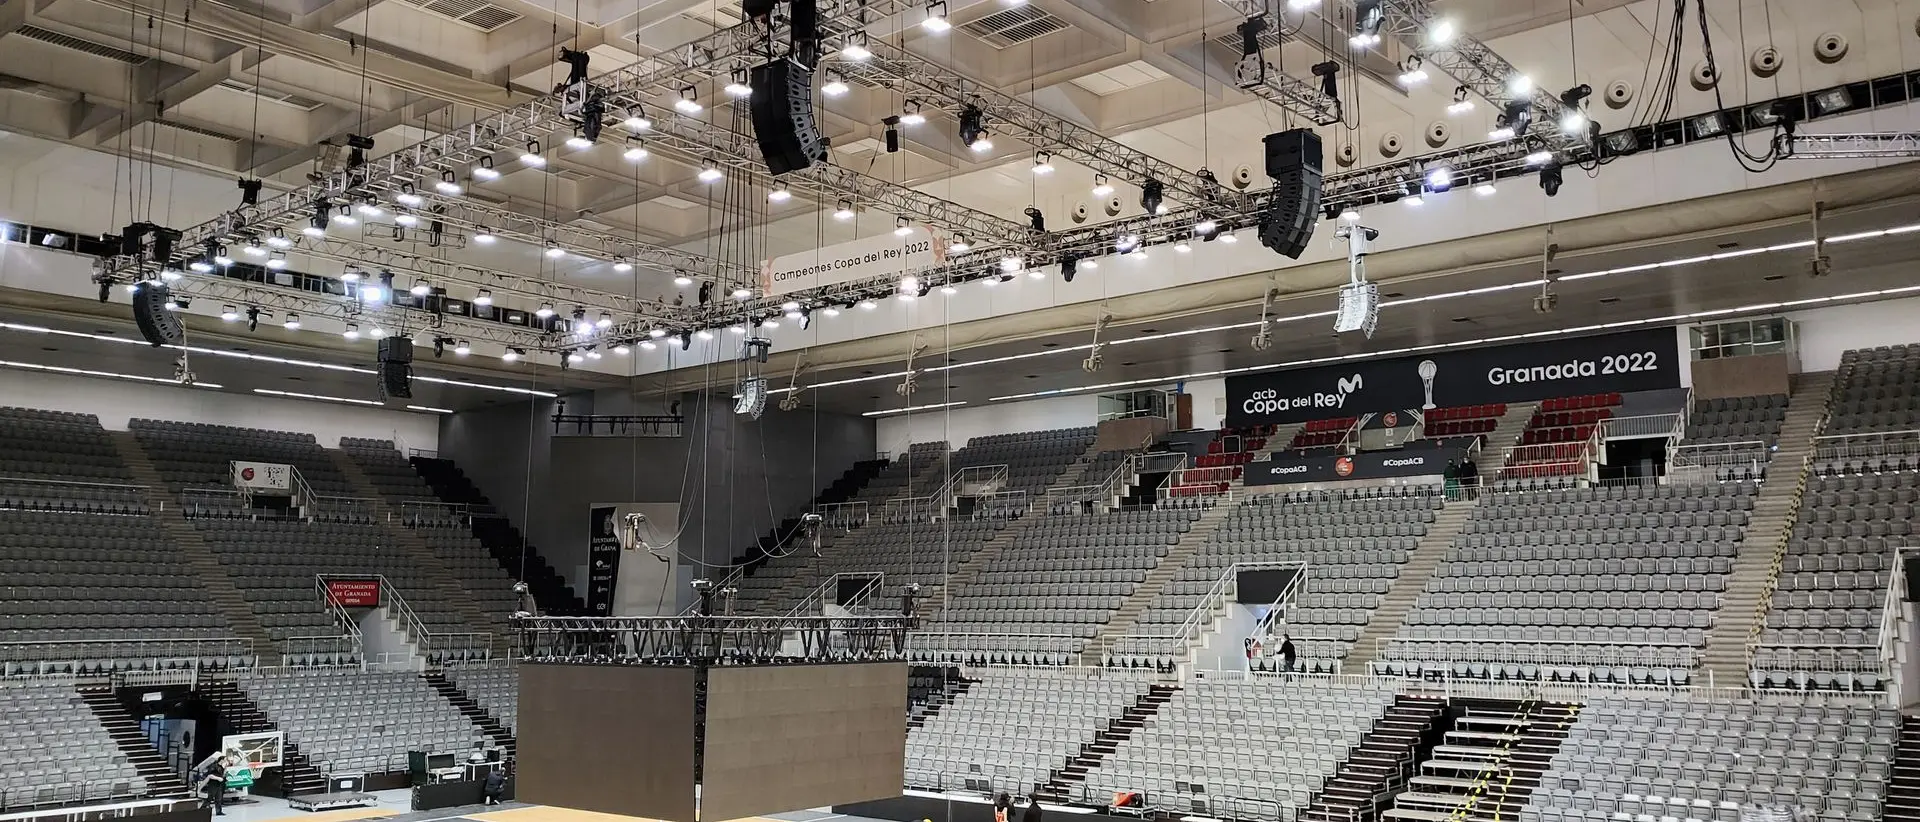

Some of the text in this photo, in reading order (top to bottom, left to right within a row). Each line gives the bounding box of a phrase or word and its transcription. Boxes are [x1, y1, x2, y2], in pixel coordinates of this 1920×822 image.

[774, 241, 929, 282] Campeones Copa del Rey 2022
[1488, 351, 1658, 385] Granada 2022
[1252, 388, 1277, 400] acb
[1243, 393, 1346, 415] Copa del Rey
[1270, 465, 1307, 475] #CopaACB
[1383, 457, 1424, 467] #CopaACB
